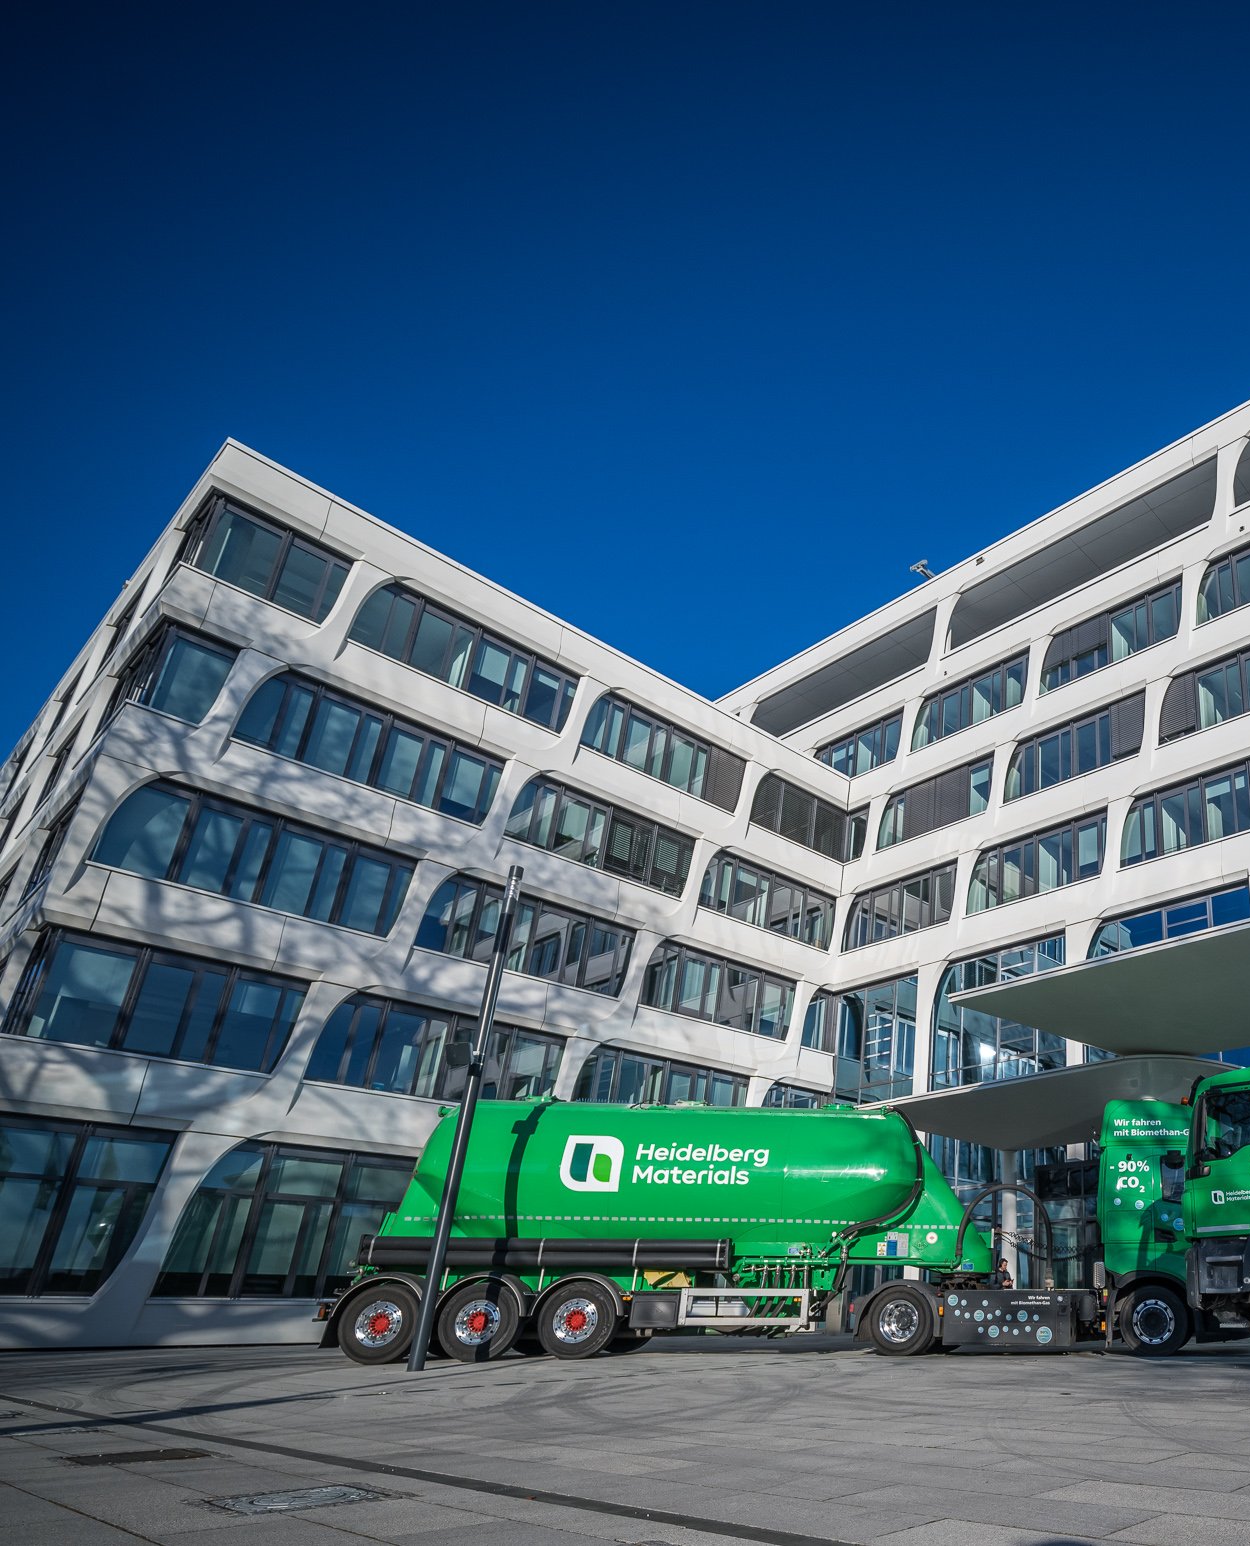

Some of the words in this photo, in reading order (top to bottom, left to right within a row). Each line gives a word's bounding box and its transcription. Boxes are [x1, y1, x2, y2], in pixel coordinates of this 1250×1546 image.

[1131, 1128, 1190, 1136] Biomethan-G
[635, 1142, 770, 1168] Heidelberg
[631, 1164, 749, 1185] Materials
